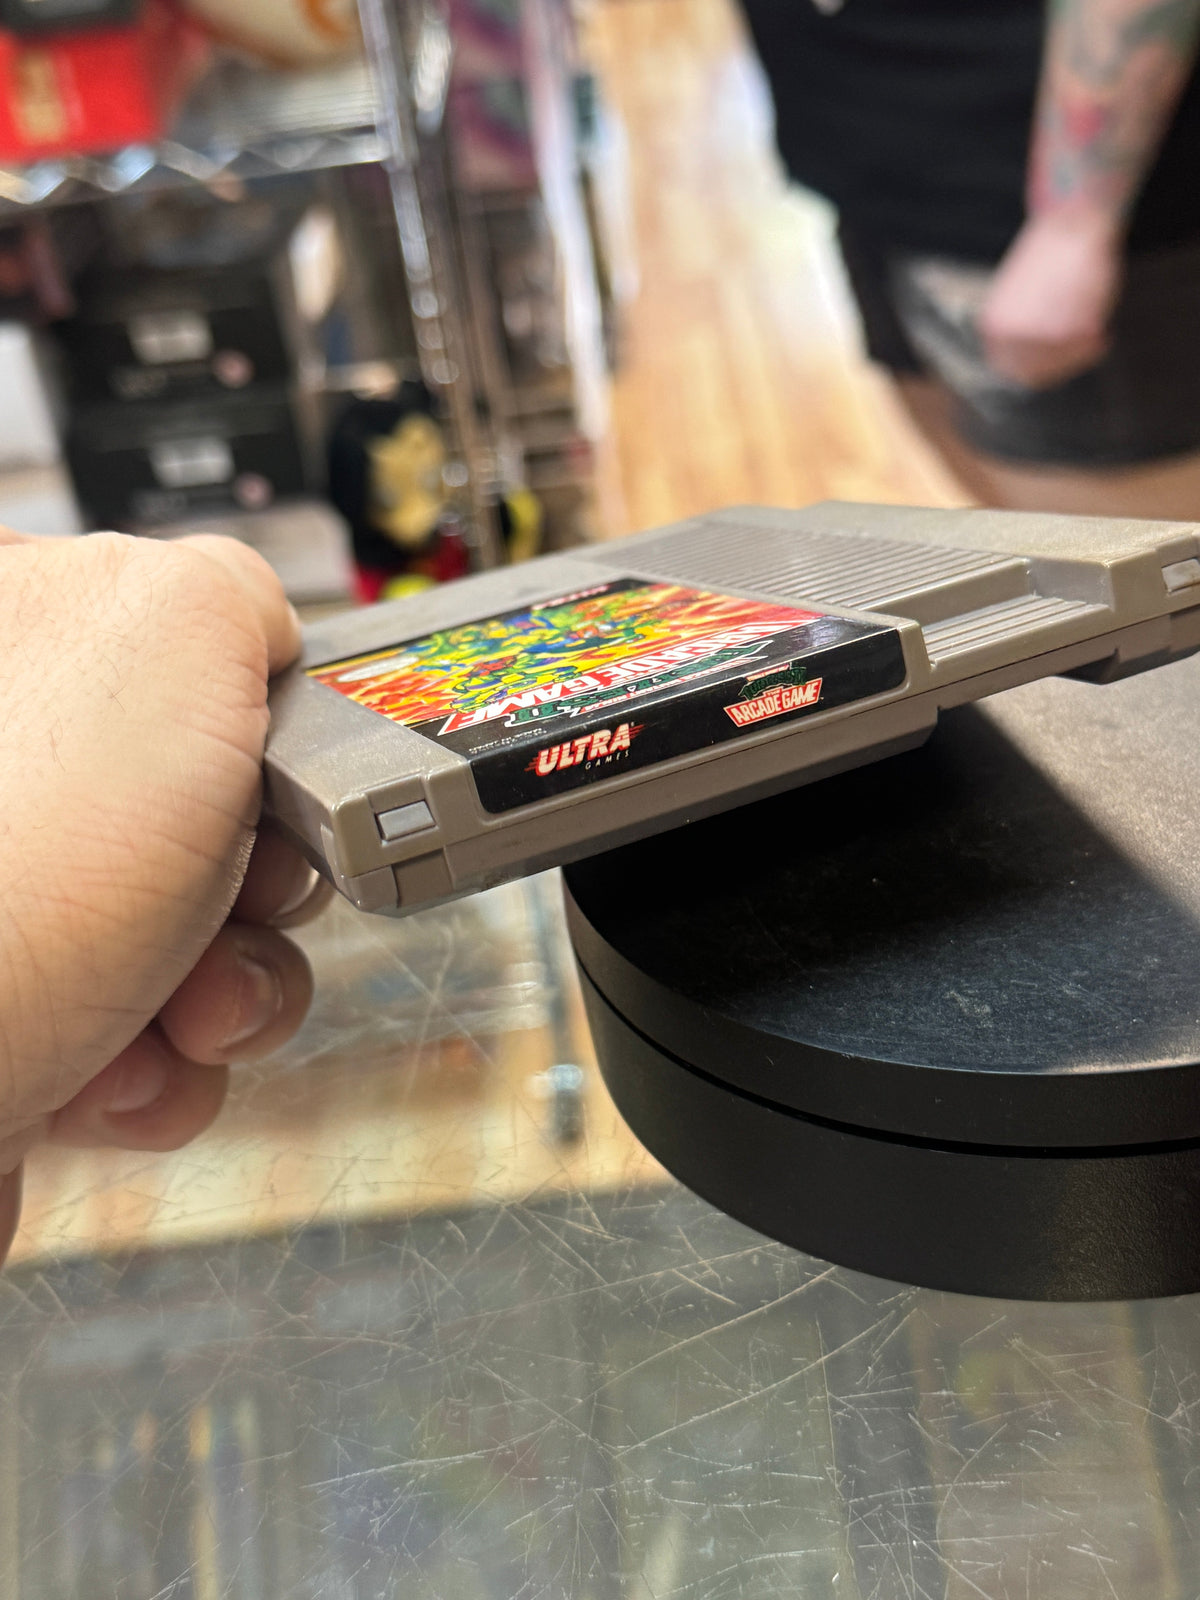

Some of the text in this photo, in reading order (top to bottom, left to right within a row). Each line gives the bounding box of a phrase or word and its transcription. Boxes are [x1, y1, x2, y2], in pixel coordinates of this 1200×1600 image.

[597, 621, 793, 682] ARCADE
[730, 681, 819, 724] ARCADE GAME
[535, 722, 631, 777] ULTRA
[585, 750, 629, 770] GAMES
